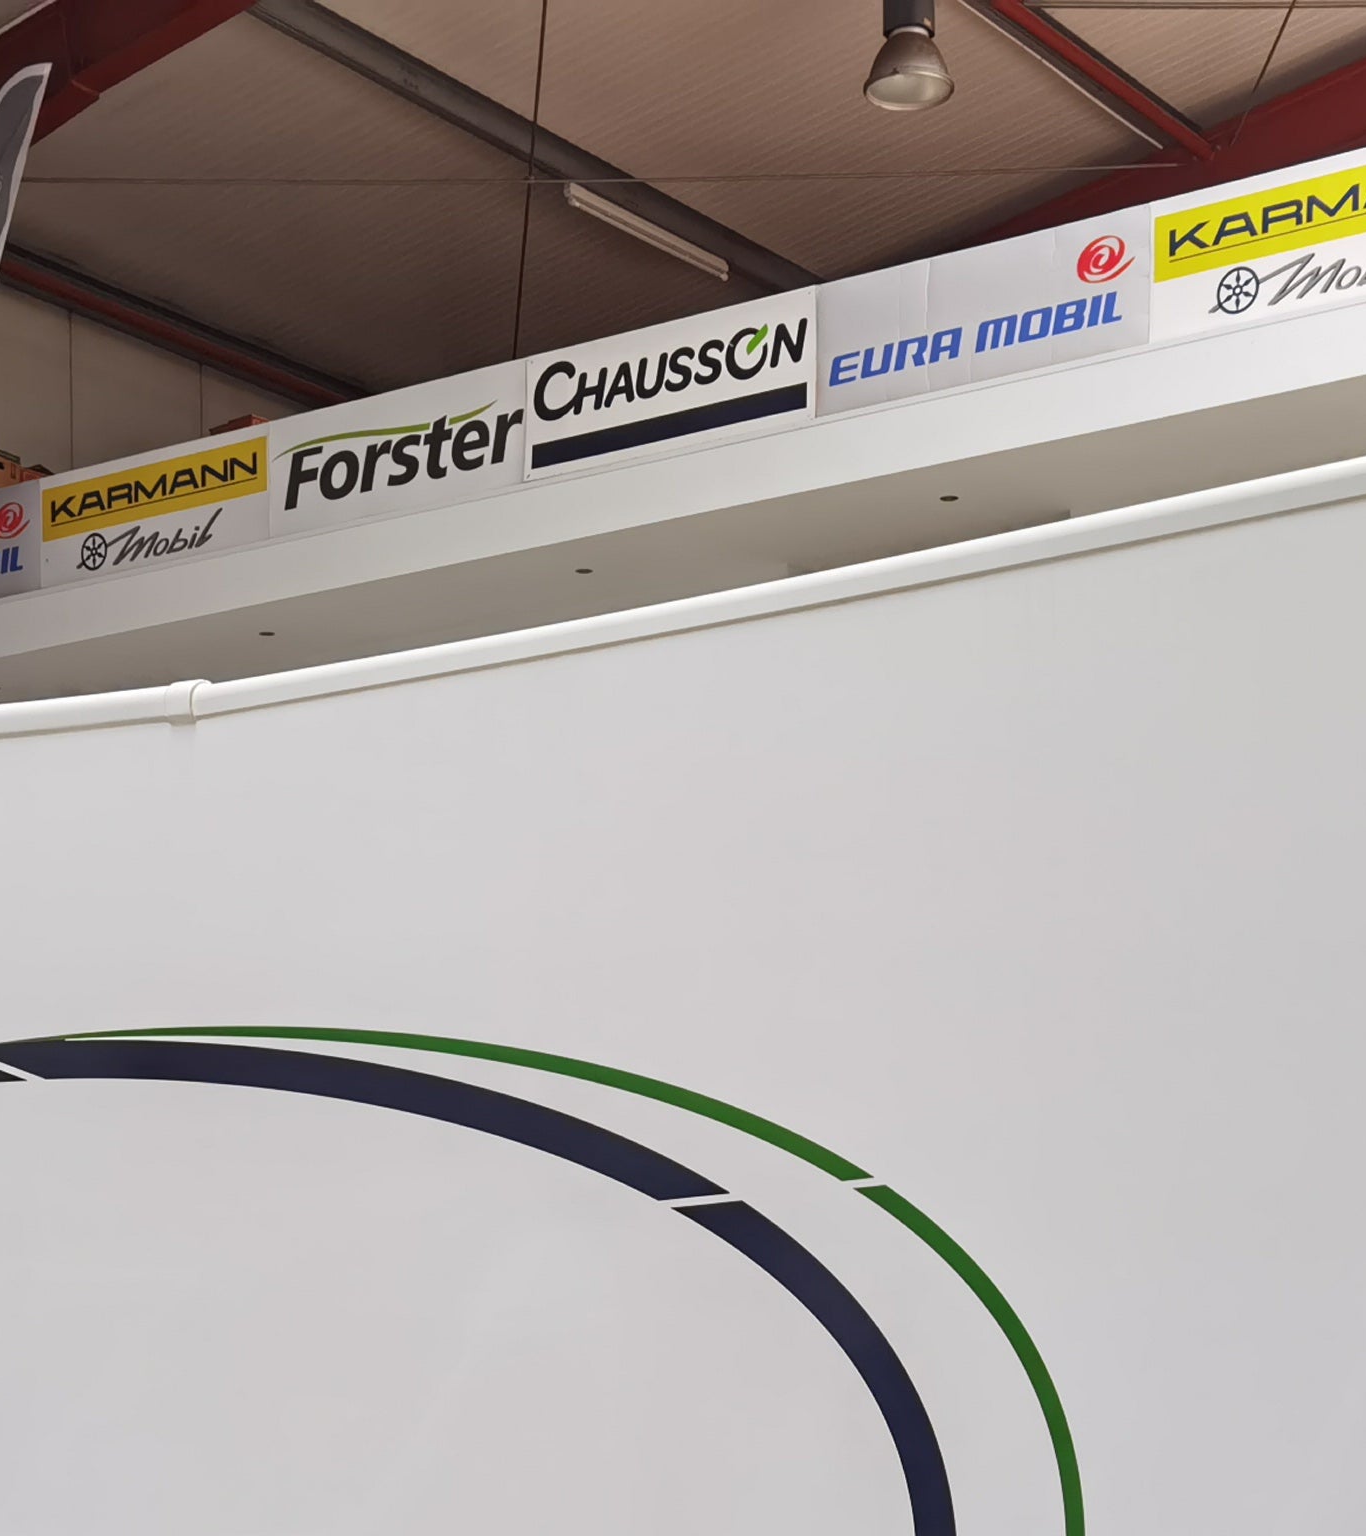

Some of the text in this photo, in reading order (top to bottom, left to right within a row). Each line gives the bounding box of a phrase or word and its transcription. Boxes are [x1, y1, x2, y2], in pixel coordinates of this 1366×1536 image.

[534, 317, 809, 421] CHAUSSON
[827, 291, 1124, 388] EURA MOBIL
[50, 450, 259, 526] KARMANN
[283, 407, 525, 512] Forster
[108, 507, 224, 566] Mobil
